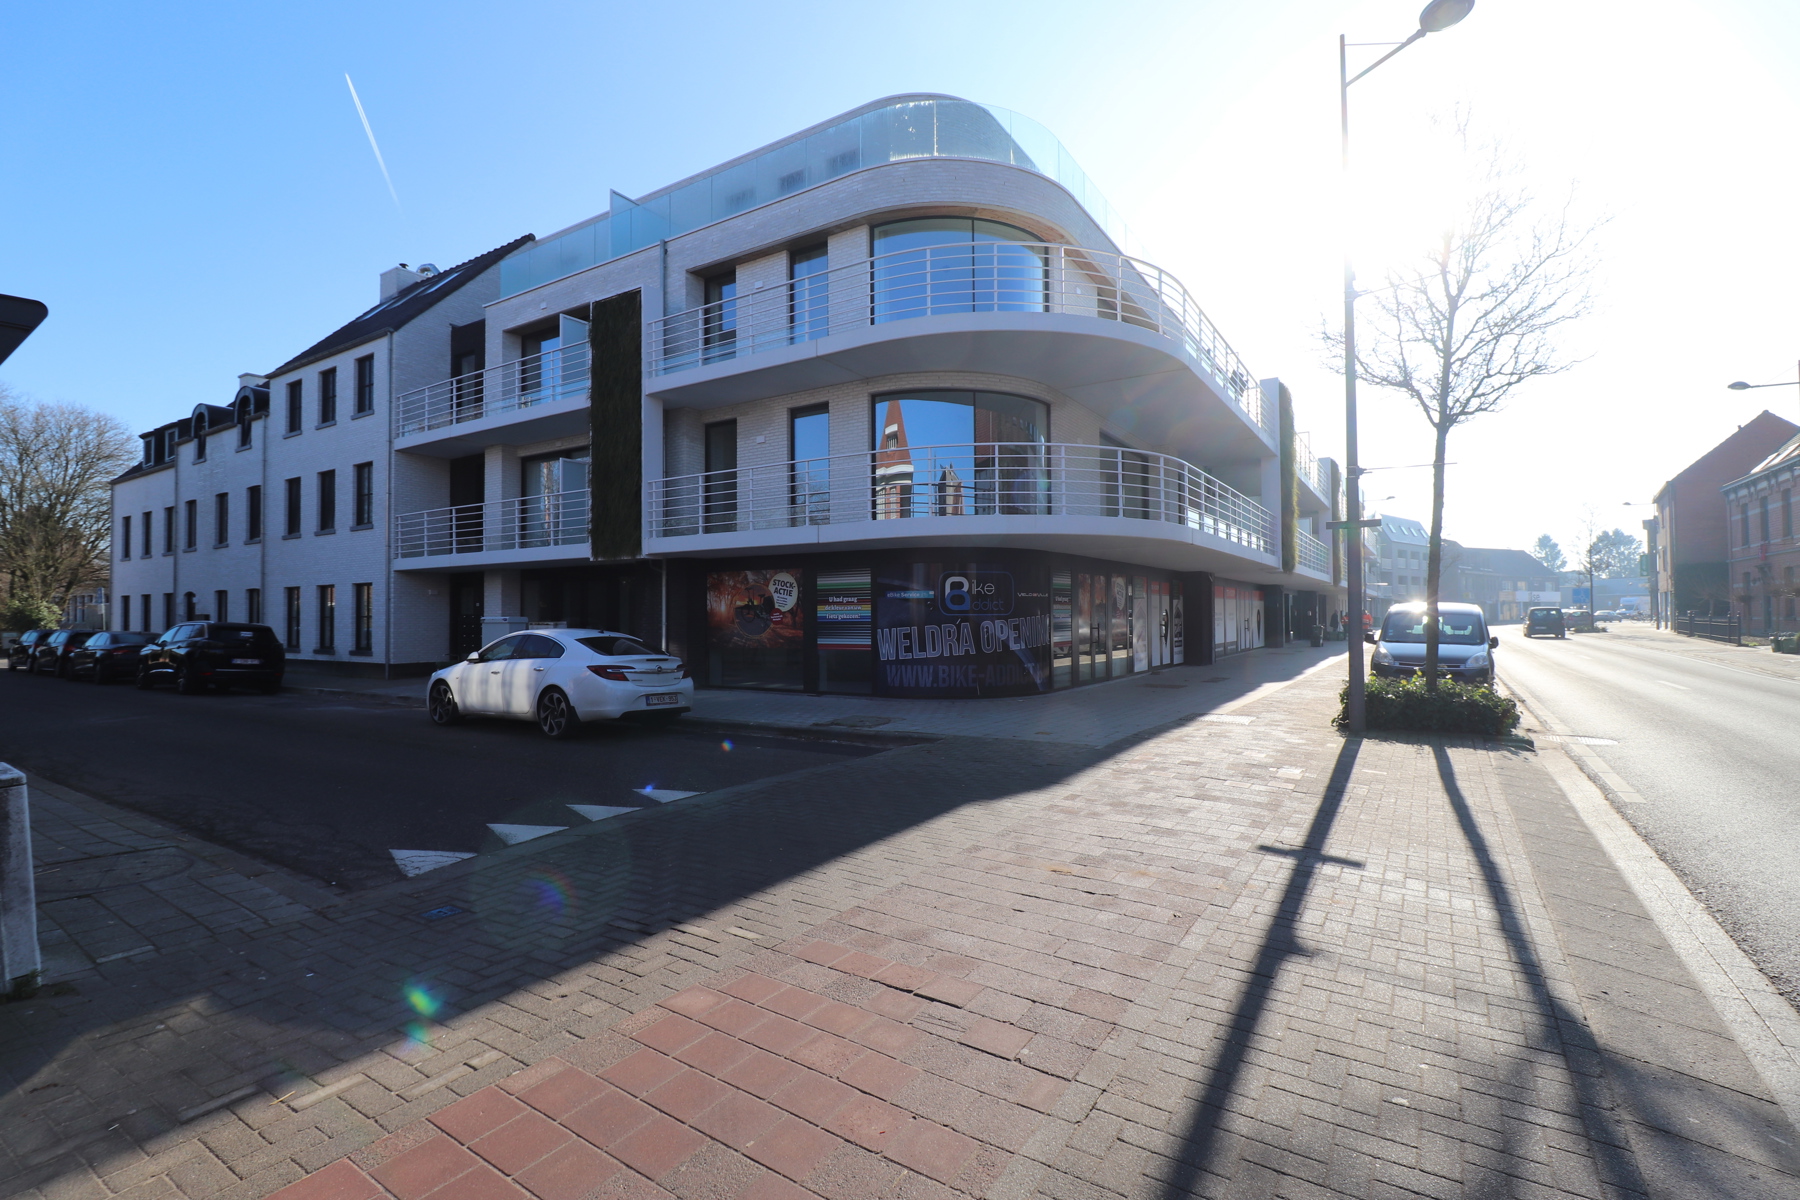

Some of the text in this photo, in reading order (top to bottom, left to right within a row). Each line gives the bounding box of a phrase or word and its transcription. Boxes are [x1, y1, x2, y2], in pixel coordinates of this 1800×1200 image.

[773, 580, 796, 589] STOCK-
[774, 587, 793, 597] ACTIE
[877, 622, 976, 661] WELDRA
